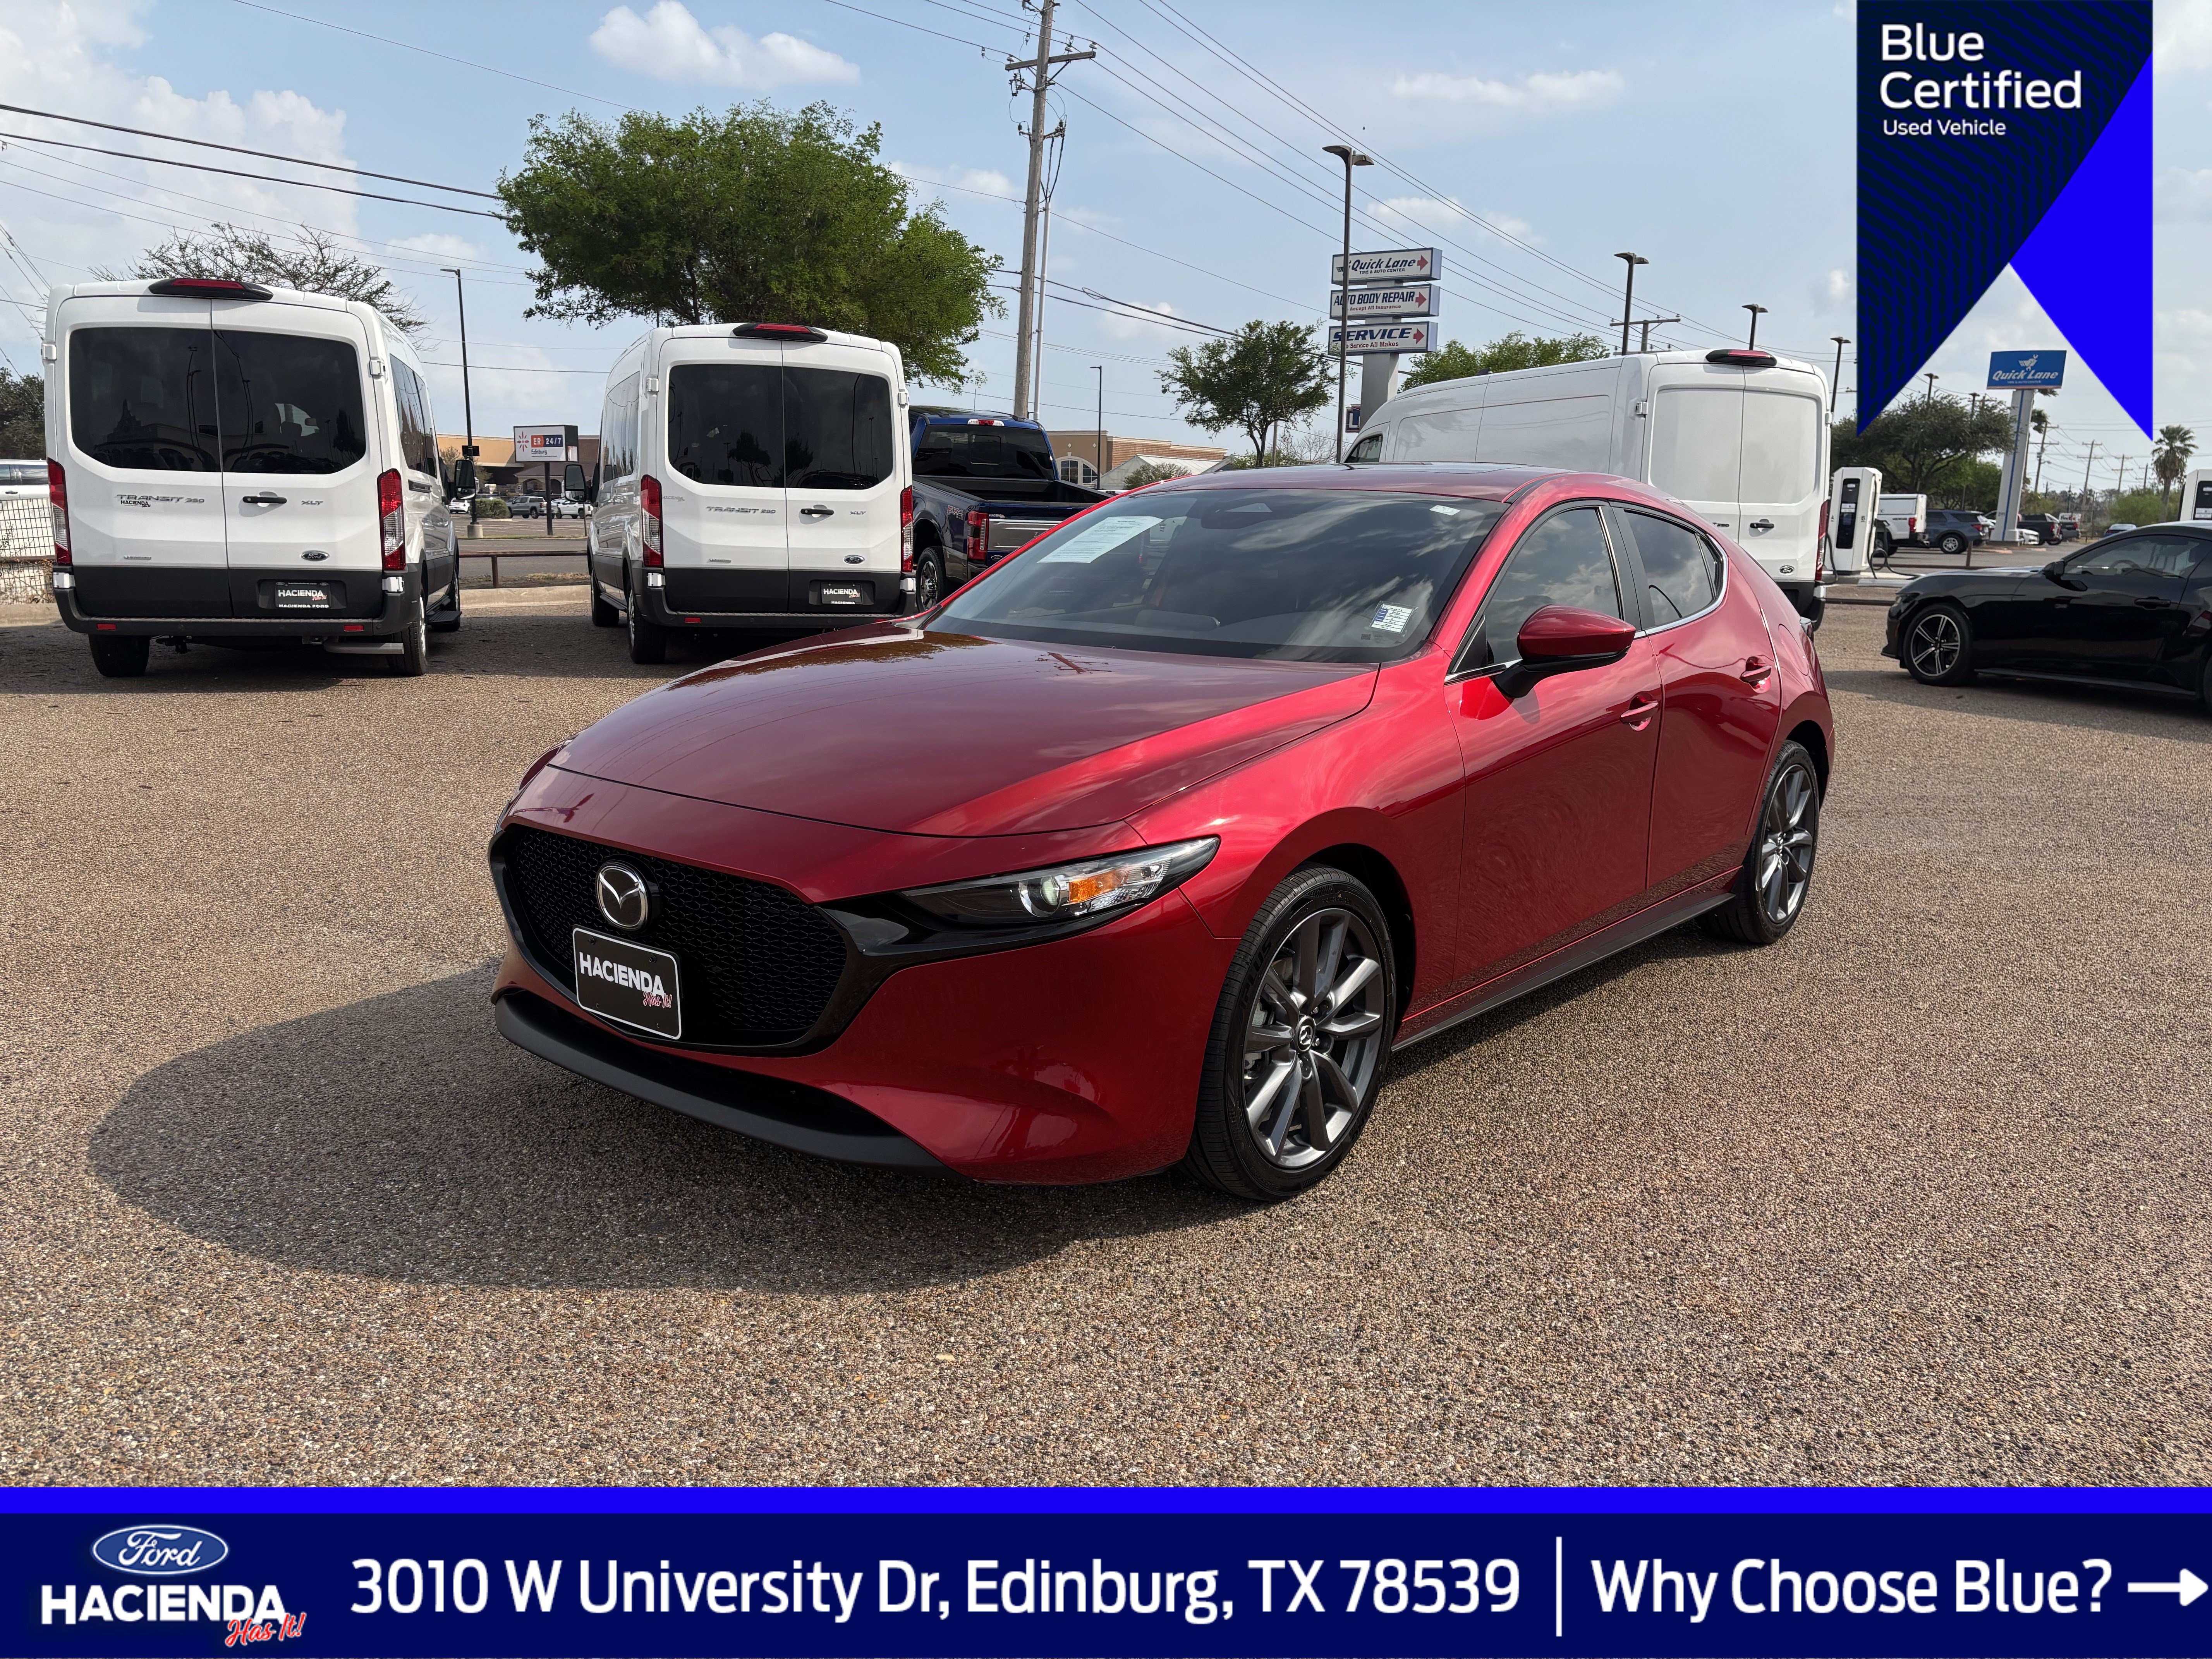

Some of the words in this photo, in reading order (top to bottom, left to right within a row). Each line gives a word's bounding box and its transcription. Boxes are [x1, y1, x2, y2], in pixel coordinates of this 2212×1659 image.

[1352, 258, 1384, 271] Quick
[1385, 258, 1416, 268] Lane
[1357, 293, 1382, 304] BODY
[1382, 291, 1415, 303] REPAIR
[1332, 328, 1412, 342] SERVICE
[1992, 370, 2027, 381] Quick
[2027, 370, 2059, 380] Lane
[116, 494, 184, 502] TRANSIT
[579, 952, 666, 997] HACIENDA
[643, 991, 662, 1007] Has
[662, 993, 672, 1008] It!
